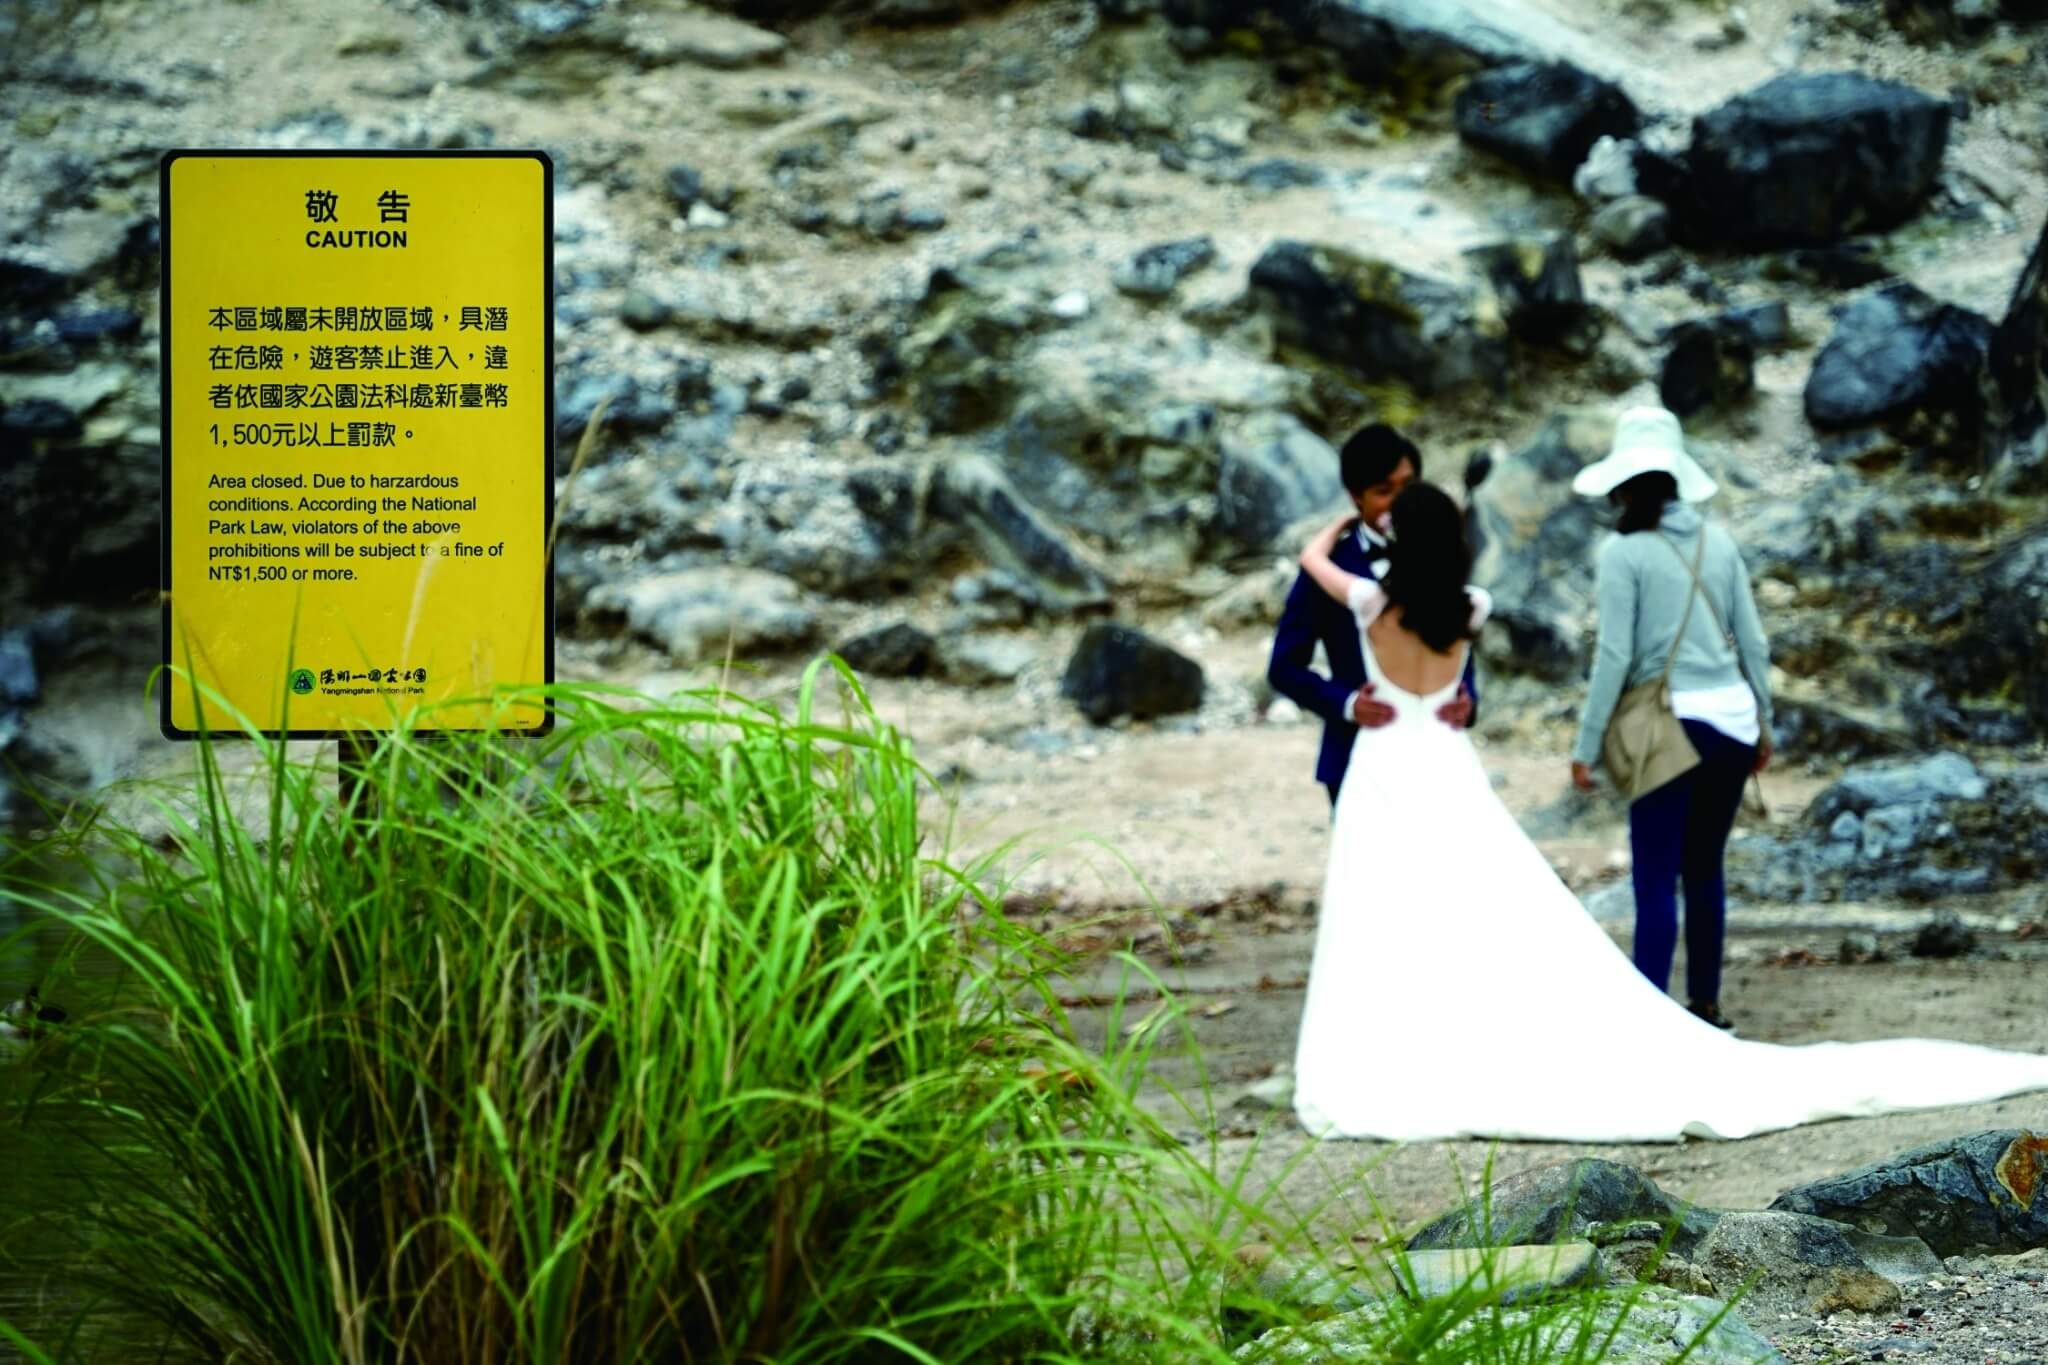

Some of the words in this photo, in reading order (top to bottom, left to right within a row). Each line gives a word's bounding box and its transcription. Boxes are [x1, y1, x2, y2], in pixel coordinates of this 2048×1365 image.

[305, 230, 407, 248] CAUTION
[208, 383, 509, 408] 者依國家公園法科處新臺幣
[208, 474, 247, 488] Area
[251, 473, 307, 488] closed.
[313, 474, 345, 488] Due
[350, 475, 365, 488] to
[370, 474, 459, 488] harzardous
[208, 497, 293, 511] conditions.
[298, 497, 376, 514] According
[382, 497, 406, 511] the
[411, 496, 476, 511] National
[208, 520, 245, 534] Park
[250, 520, 286, 536] Law,
[292, 519, 358, 534] violators
[363, 519, 379, 534] of
[383, 520, 407, 534] the
[412, 520, 460, 534] above
[208, 542, 300, 560] prohibitions
[305, 542, 329, 557] will
[335, 542, 354, 557] be
[359, 542, 416, 560] subject
[441, 546, 449, 557] a
[454, 542, 483, 557] fine
[488, 542, 504, 557] of
[208, 565, 287, 582] NT$1,500
[292, 568, 308, 581] or
[313, 568, 357, 581] more.
[321, 687, 375, 696] Yangmingshan
[408, 686, 425, 695] Park
